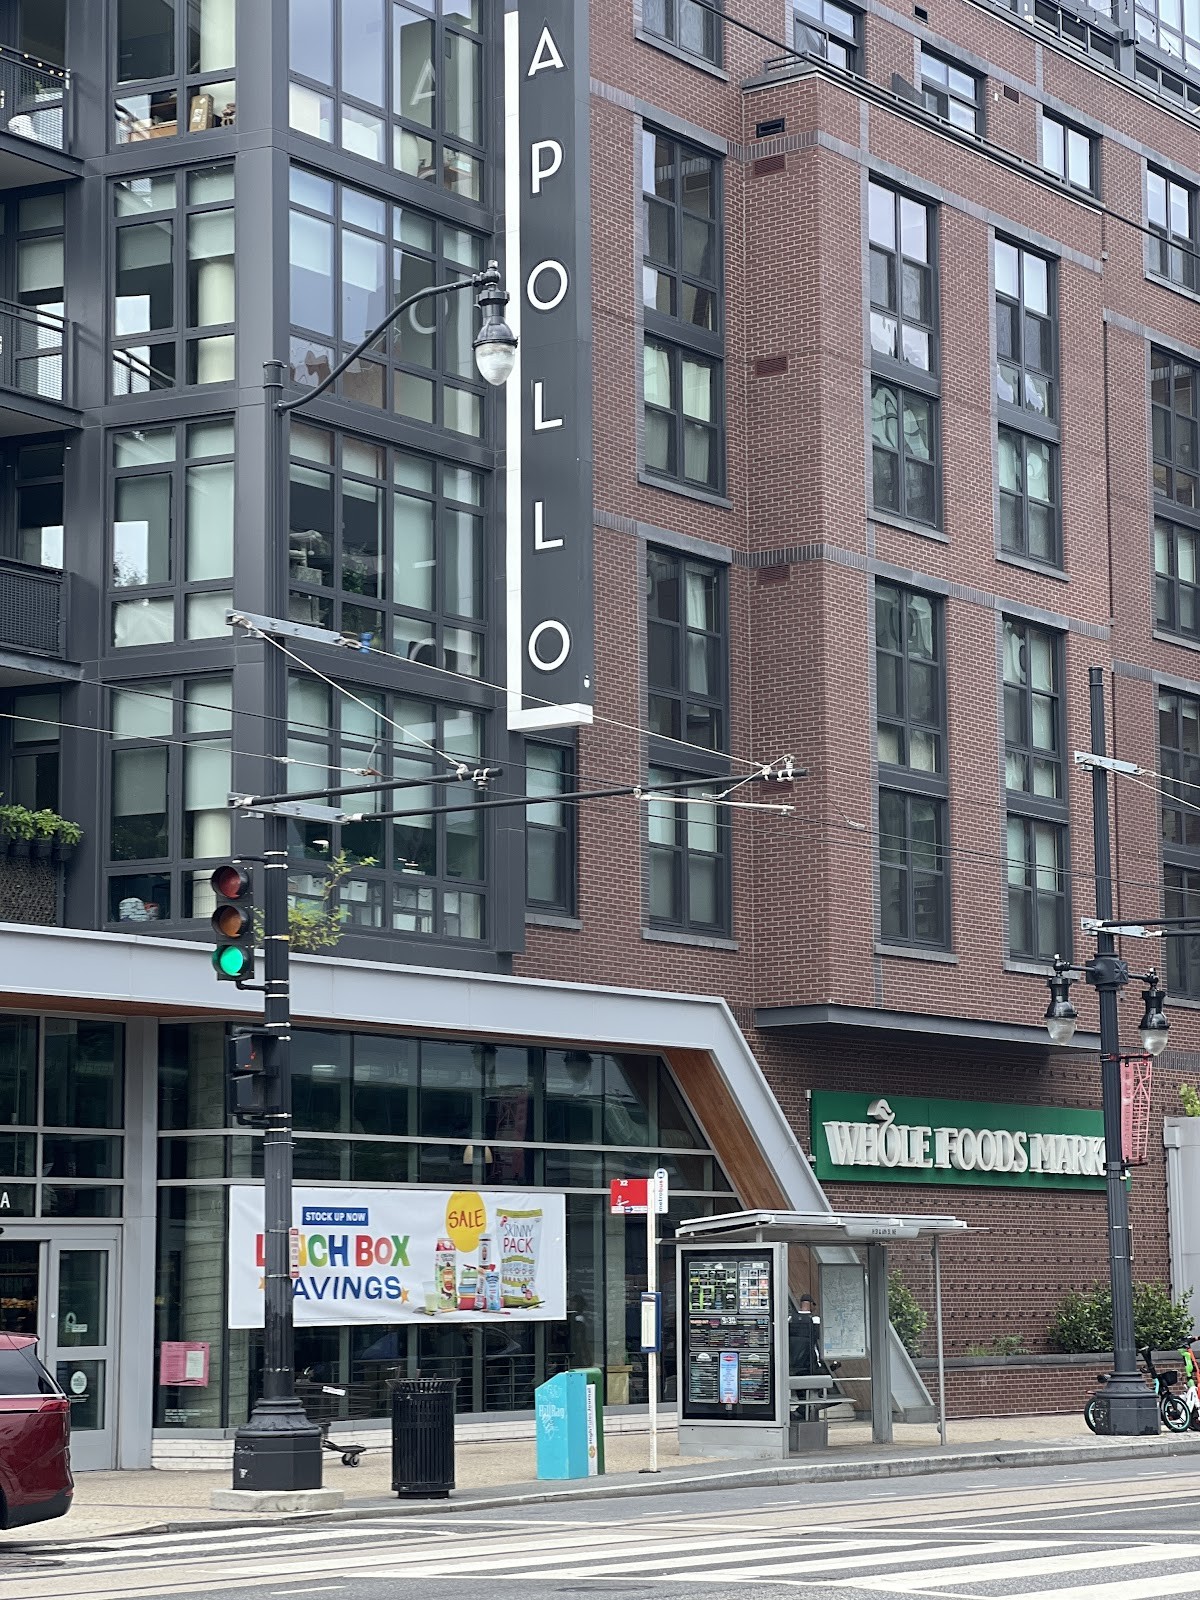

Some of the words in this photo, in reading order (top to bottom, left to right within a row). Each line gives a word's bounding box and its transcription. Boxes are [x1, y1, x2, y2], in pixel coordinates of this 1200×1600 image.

[526, 25, 571, 672] APOLLO
[823, 1118, 933, 1168] WHOLE
[934, 1127, 1028, 1173] FOODS
[1029, 1133, 1107, 1176] MARK
[305, 1212, 333, 1221] STOCK
[334, 1212, 345, 1221] UP
[346, 1213, 366, 1221] NOW
[448, 1208, 485, 1228] SALE
[503, 1222, 534, 1237] SKINNY
[255, 1234, 349, 1267] LCH
[355, 1235, 411, 1267] BOX
[503, 1237, 534, 1253] PACK
[293, 1275, 402, 1300] AVINGS
